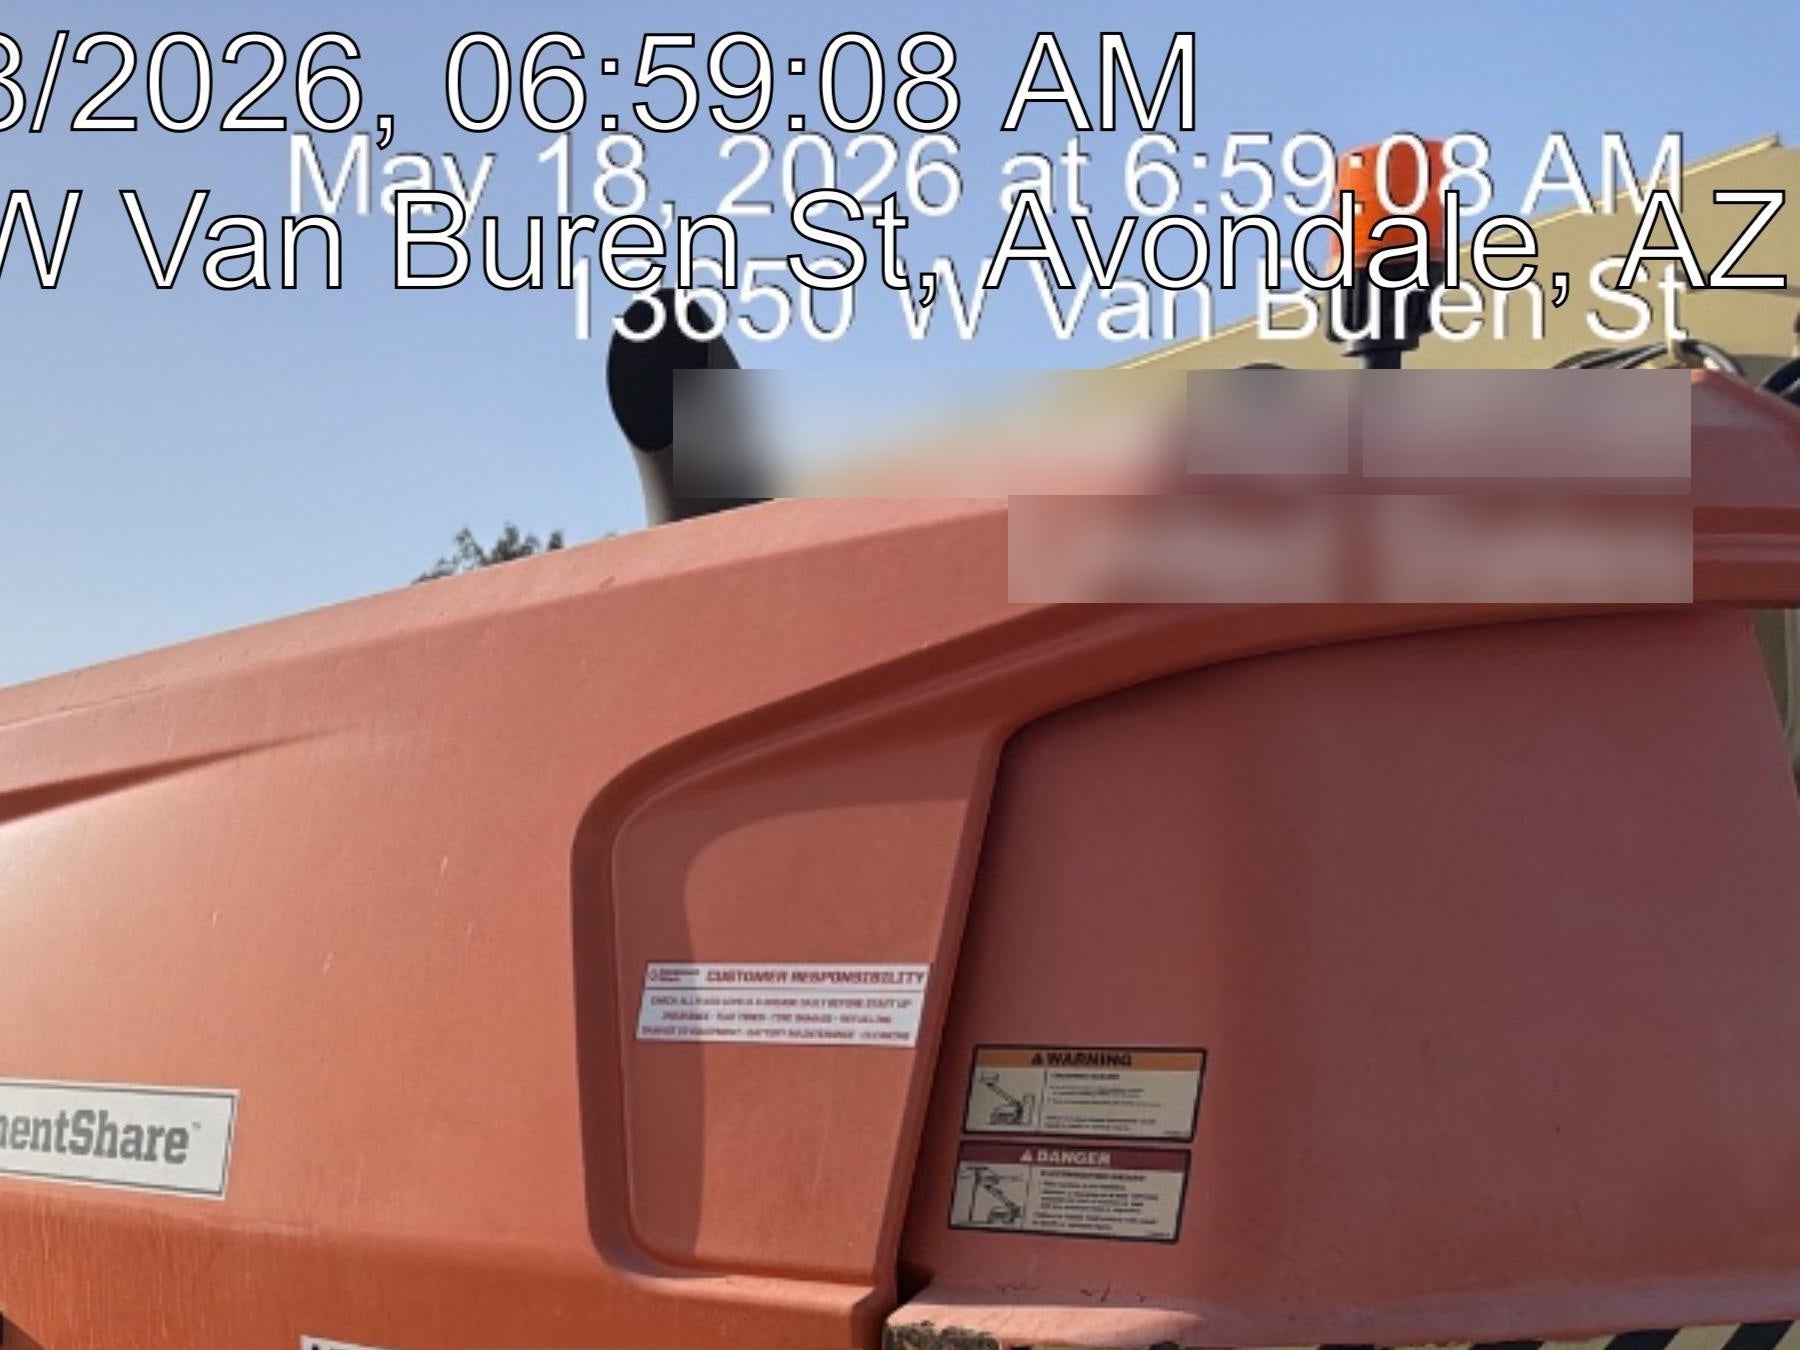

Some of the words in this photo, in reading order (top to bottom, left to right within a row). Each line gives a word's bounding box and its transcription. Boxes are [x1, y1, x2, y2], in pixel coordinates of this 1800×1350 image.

[705, 969, 789, 983] CUSTOMER
[791, 970, 925, 985] RESPONSIBILITY
[1047, 1053, 1133, 1067] WARNING
[1036, 1150, 1112, 1166] DANGER
